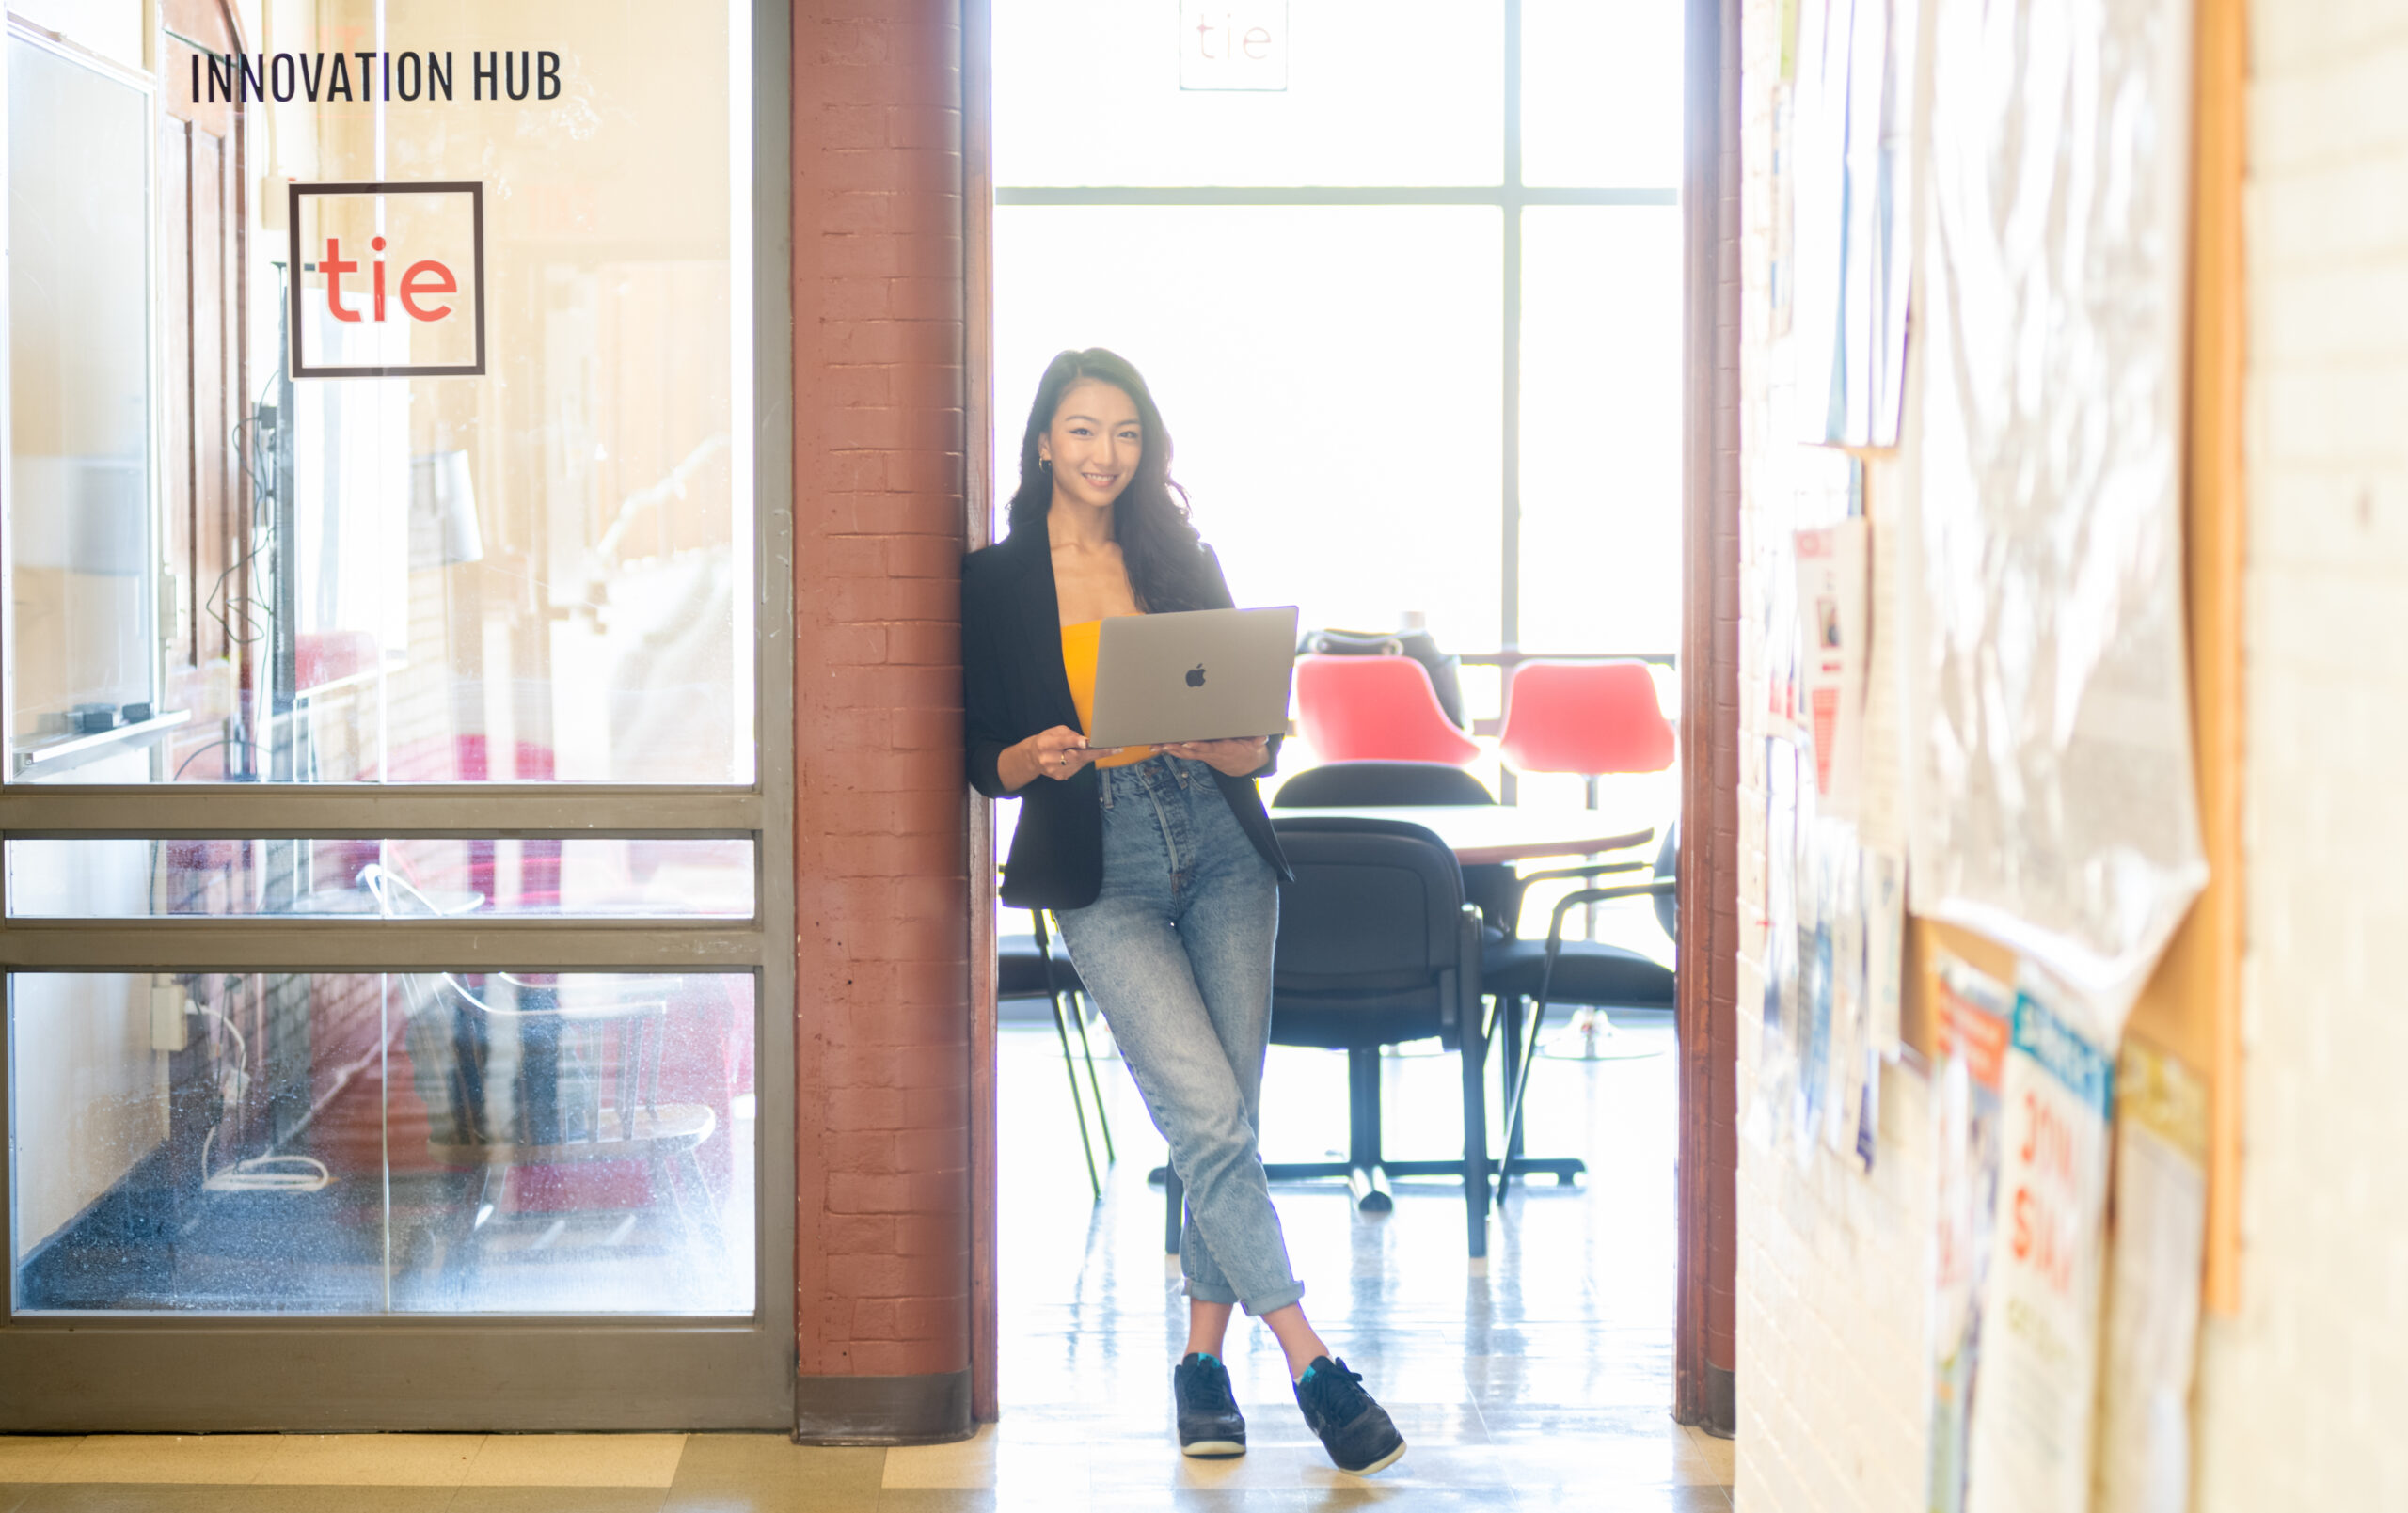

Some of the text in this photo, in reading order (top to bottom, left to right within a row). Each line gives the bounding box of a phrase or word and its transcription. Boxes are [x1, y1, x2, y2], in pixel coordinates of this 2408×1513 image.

[1196, 13, 1272, 60] tie
[191, 51, 562, 103] INNOVATION HUB
[318, 236, 458, 323] tie
